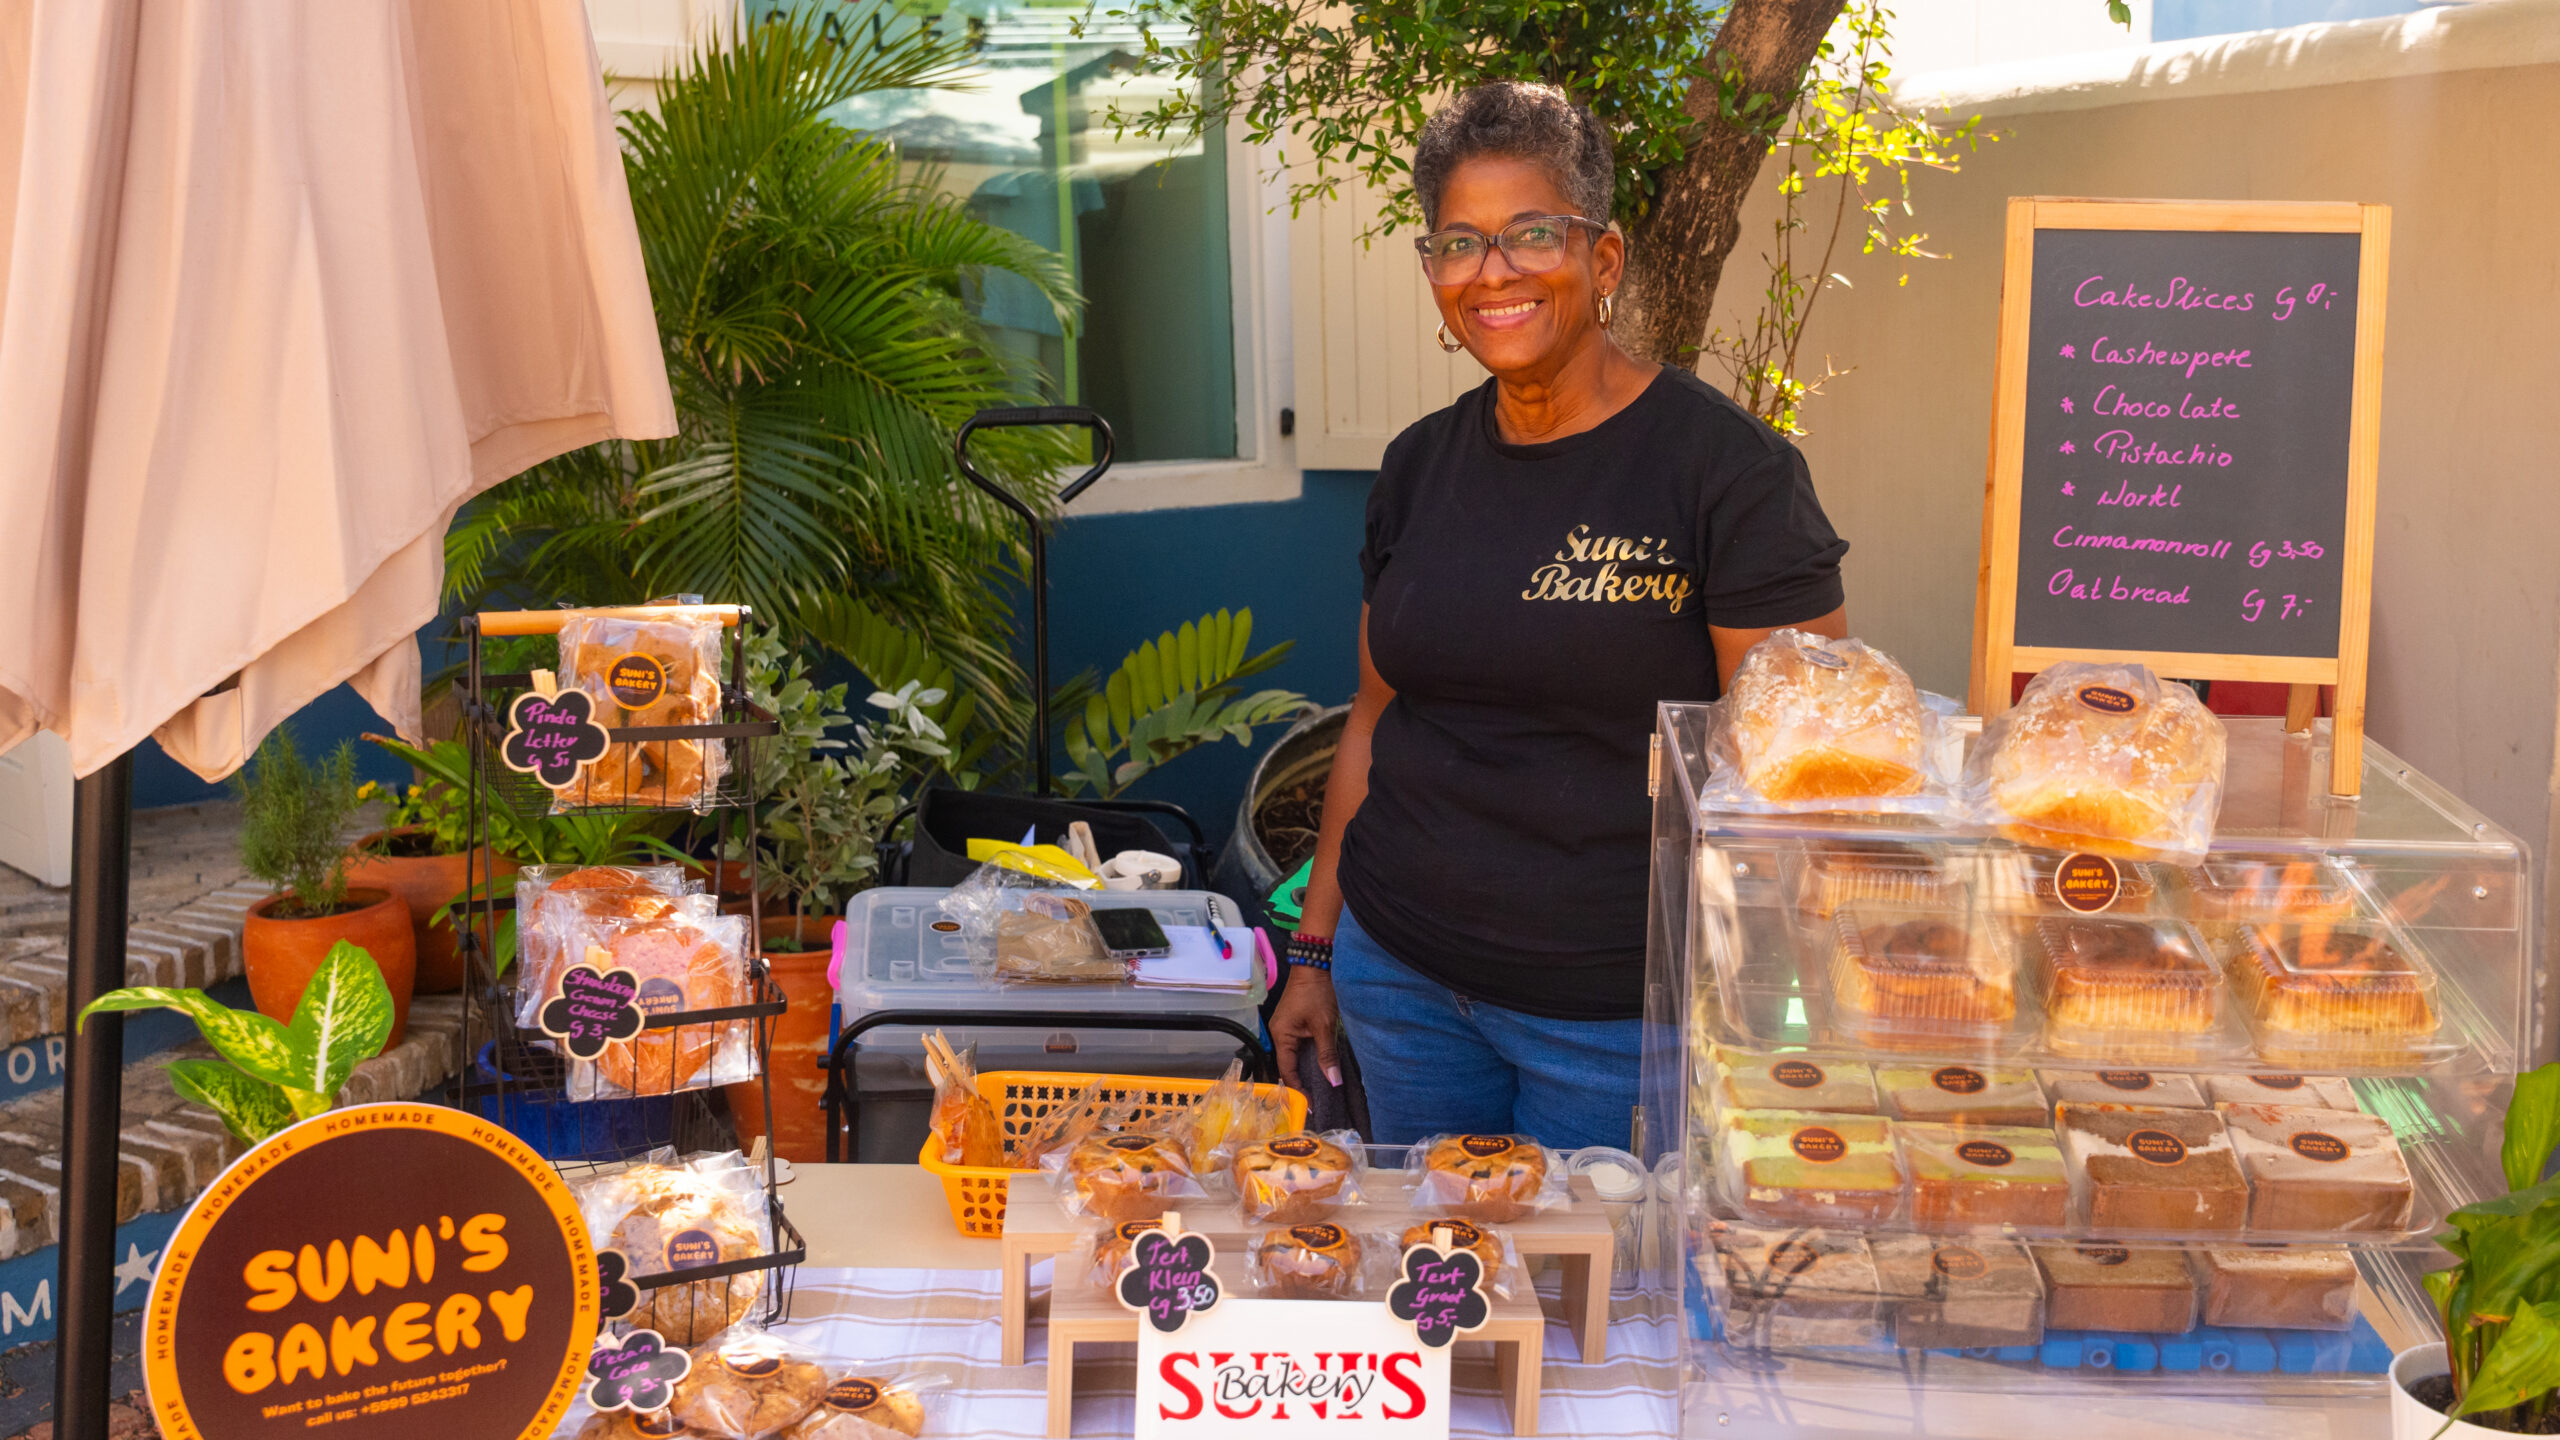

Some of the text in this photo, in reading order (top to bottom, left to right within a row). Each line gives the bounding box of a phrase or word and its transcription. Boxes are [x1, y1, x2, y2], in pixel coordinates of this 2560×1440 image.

[2094, 429, 2233, 467] Pistachio
[1555, 524, 1677, 565] Suni's
[1521, 561, 1695, 614] Bakery
[614, 677, 658, 690] BAKERY
[620, 667, 656, 680] SUNI'S
[524, 701, 577, 725] Pinda
[2065, 878, 2109, 889] BAKERY
[2071, 867, 2104, 878] SUNI'S
[326, 1111, 435, 1133] HOMEMADE
[201, 1139, 294, 1221] HOMEMADE
[471, 1126, 554, 1192] HOMEMADE
[243, 1213, 509, 1313] SUNI'S
[564, 1214, 591, 1313] HOMEMADE
[673, 1251, 714, 1262] BAKERY
[675, 1241, 711, 1251] SUNI'S
[1415, 1261, 1466, 1285] Tert
[157, 1249, 191, 1360] HOMEMADE
[223, 1284, 534, 1395] BAKERY
[261, 1358, 508, 1419] Want to bake the future together?
[305, 1382, 471, 1428] call us: +5999 5243317
[522, 1352, 582, 1440] HOMEMAD
[1159, 1351, 1427, 1421] SUNI'S
[1218, 1361, 1375, 1410] Bakery
